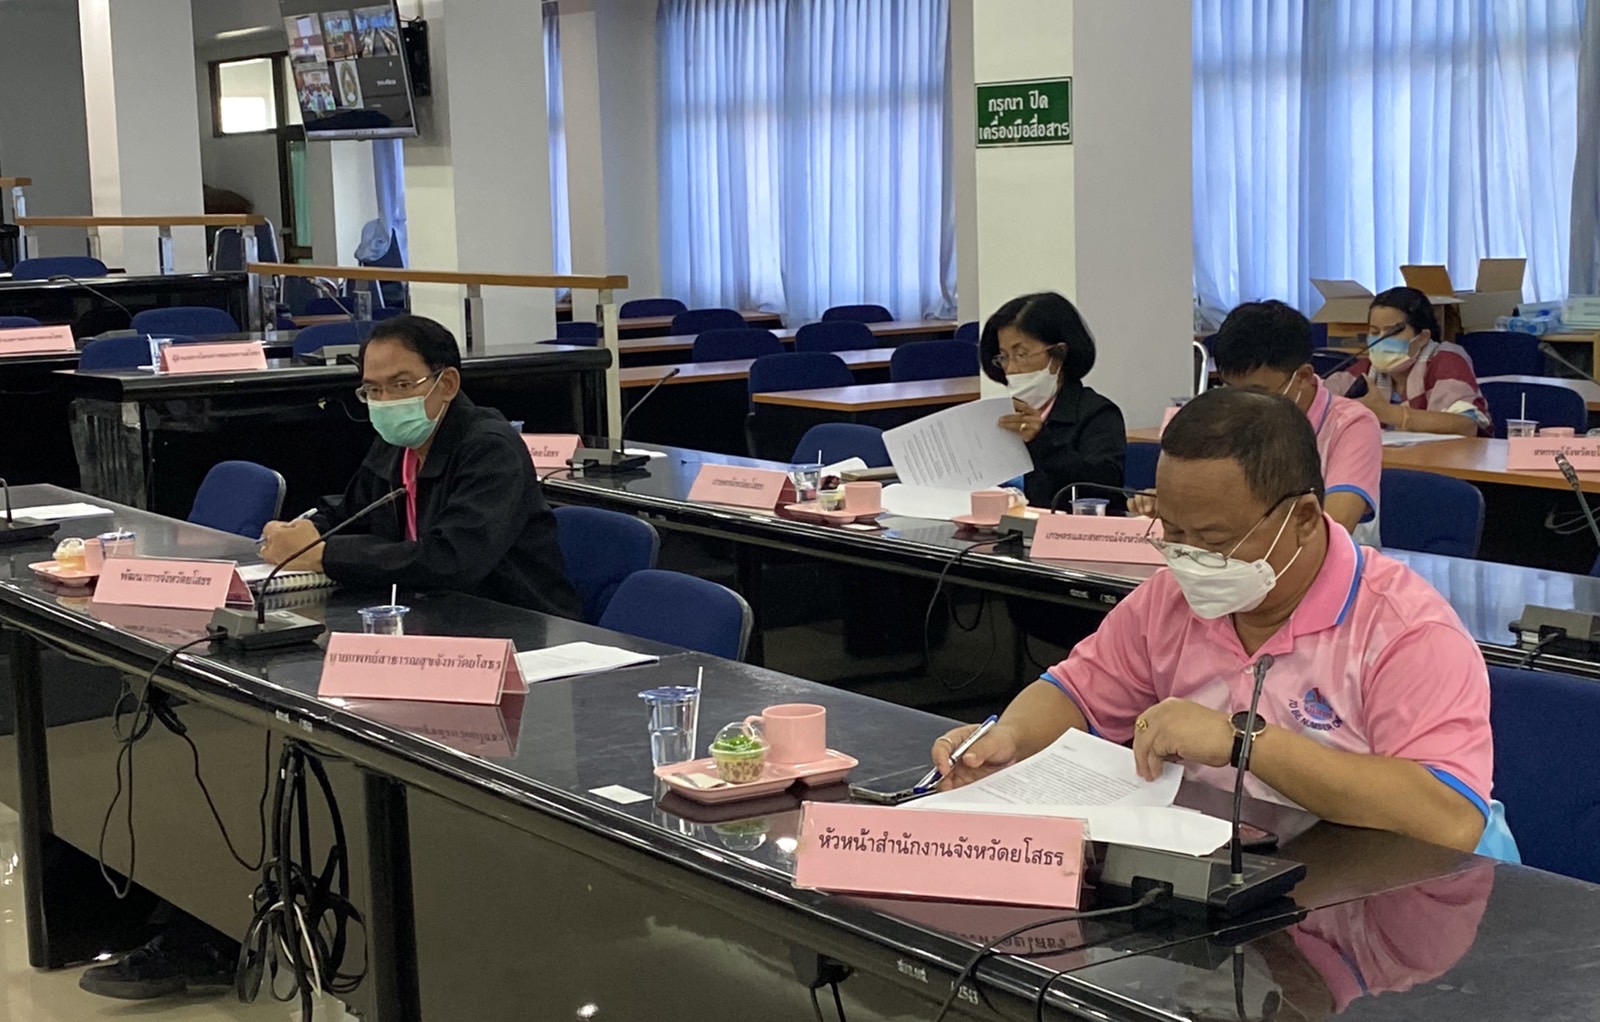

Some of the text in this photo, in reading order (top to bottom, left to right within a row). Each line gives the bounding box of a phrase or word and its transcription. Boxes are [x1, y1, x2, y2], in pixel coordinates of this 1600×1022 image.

[988, 89, 1049, 117] กรุณา ปิด
[979, 113, 1070, 140] เครื่องมือสื่อสาร
[818, 826, 1065, 867] หัวหน้าสำนักงานจังหวัดยโสธร
